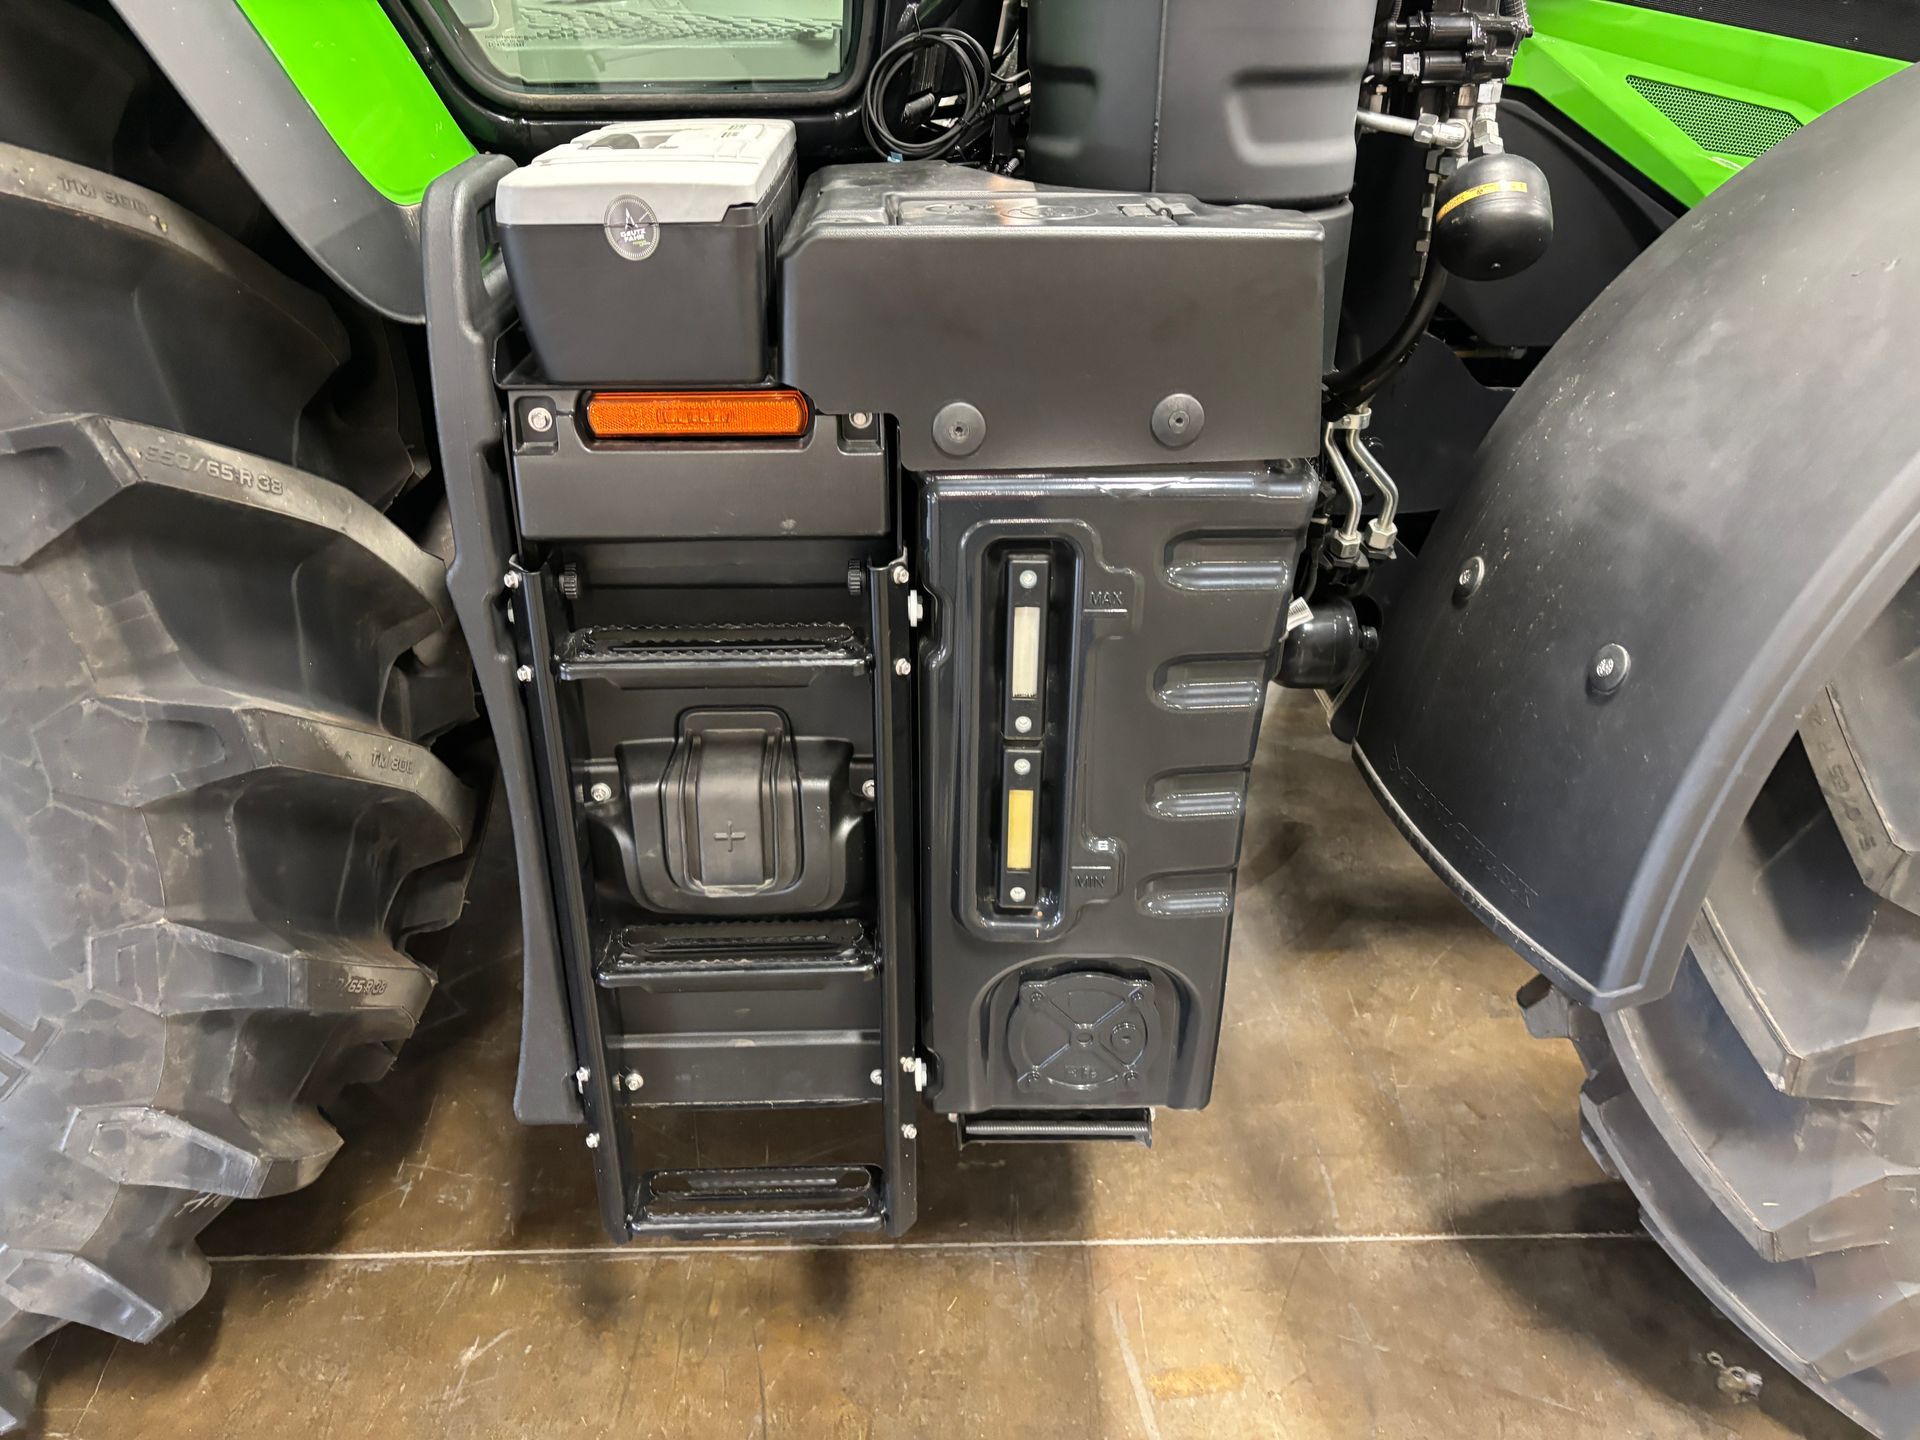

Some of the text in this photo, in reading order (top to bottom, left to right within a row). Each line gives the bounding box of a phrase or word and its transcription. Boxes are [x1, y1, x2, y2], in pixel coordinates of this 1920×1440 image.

[57, 176, 97, 199] TM
[1090, 591, 1123, 606] MAX
[1075, 875, 1105, 889] MIN
